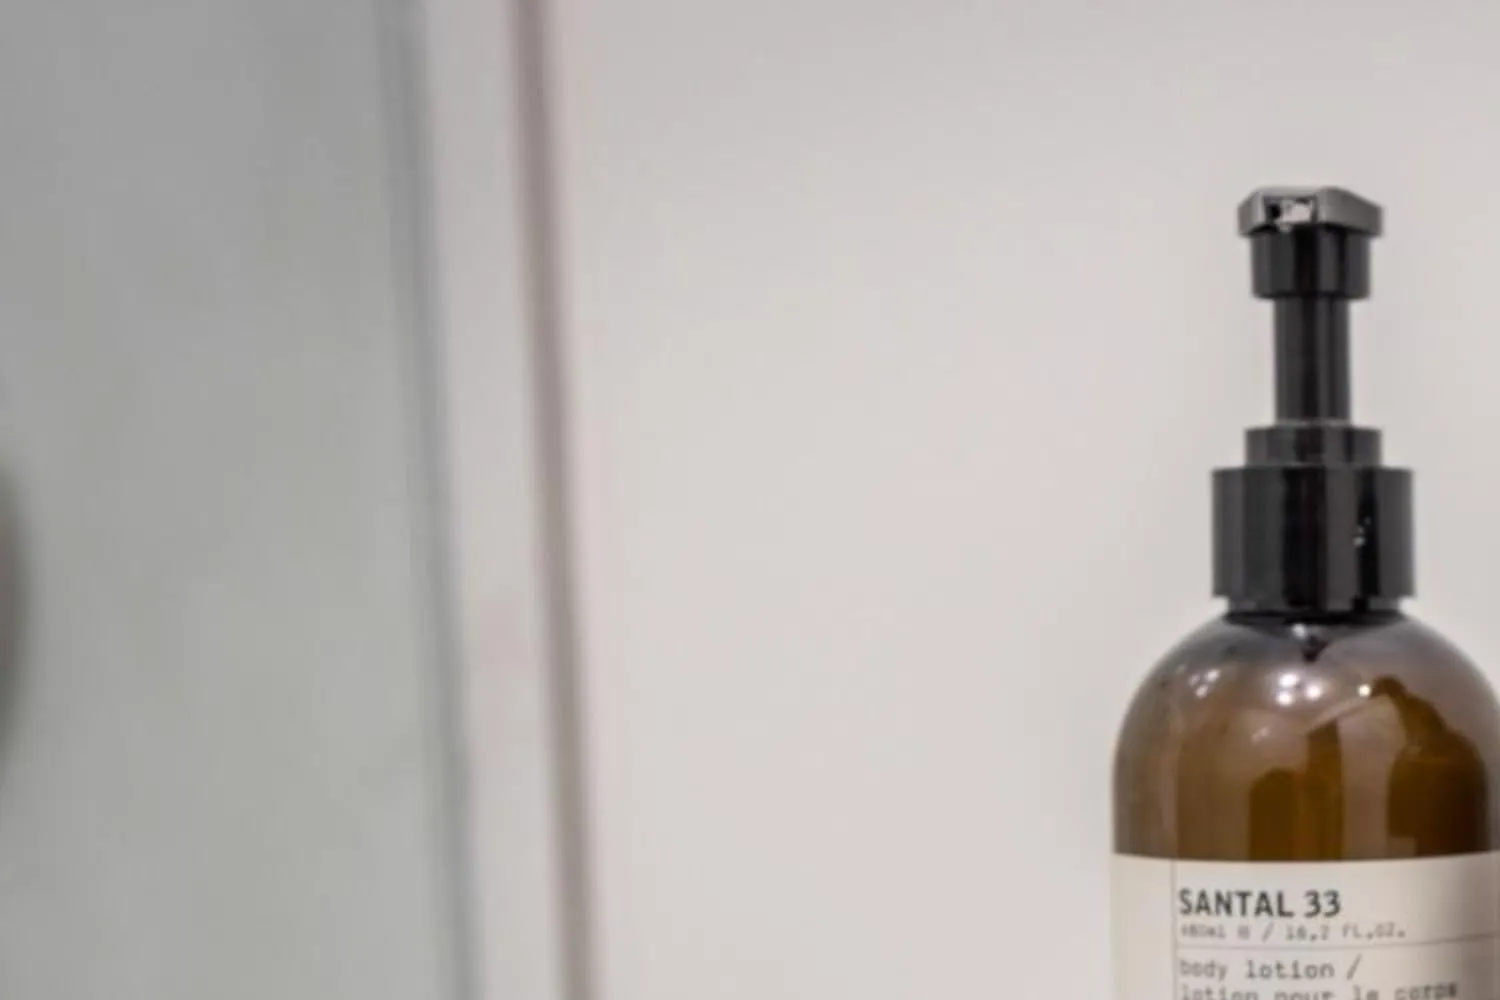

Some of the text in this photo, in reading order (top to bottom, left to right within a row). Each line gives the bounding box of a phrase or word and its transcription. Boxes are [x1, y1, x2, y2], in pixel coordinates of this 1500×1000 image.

[1179, 888, 1342, 918] SANTAL 33
[1180, 958, 1229, 982] body
[1245, 958, 1335, 980] lotion
